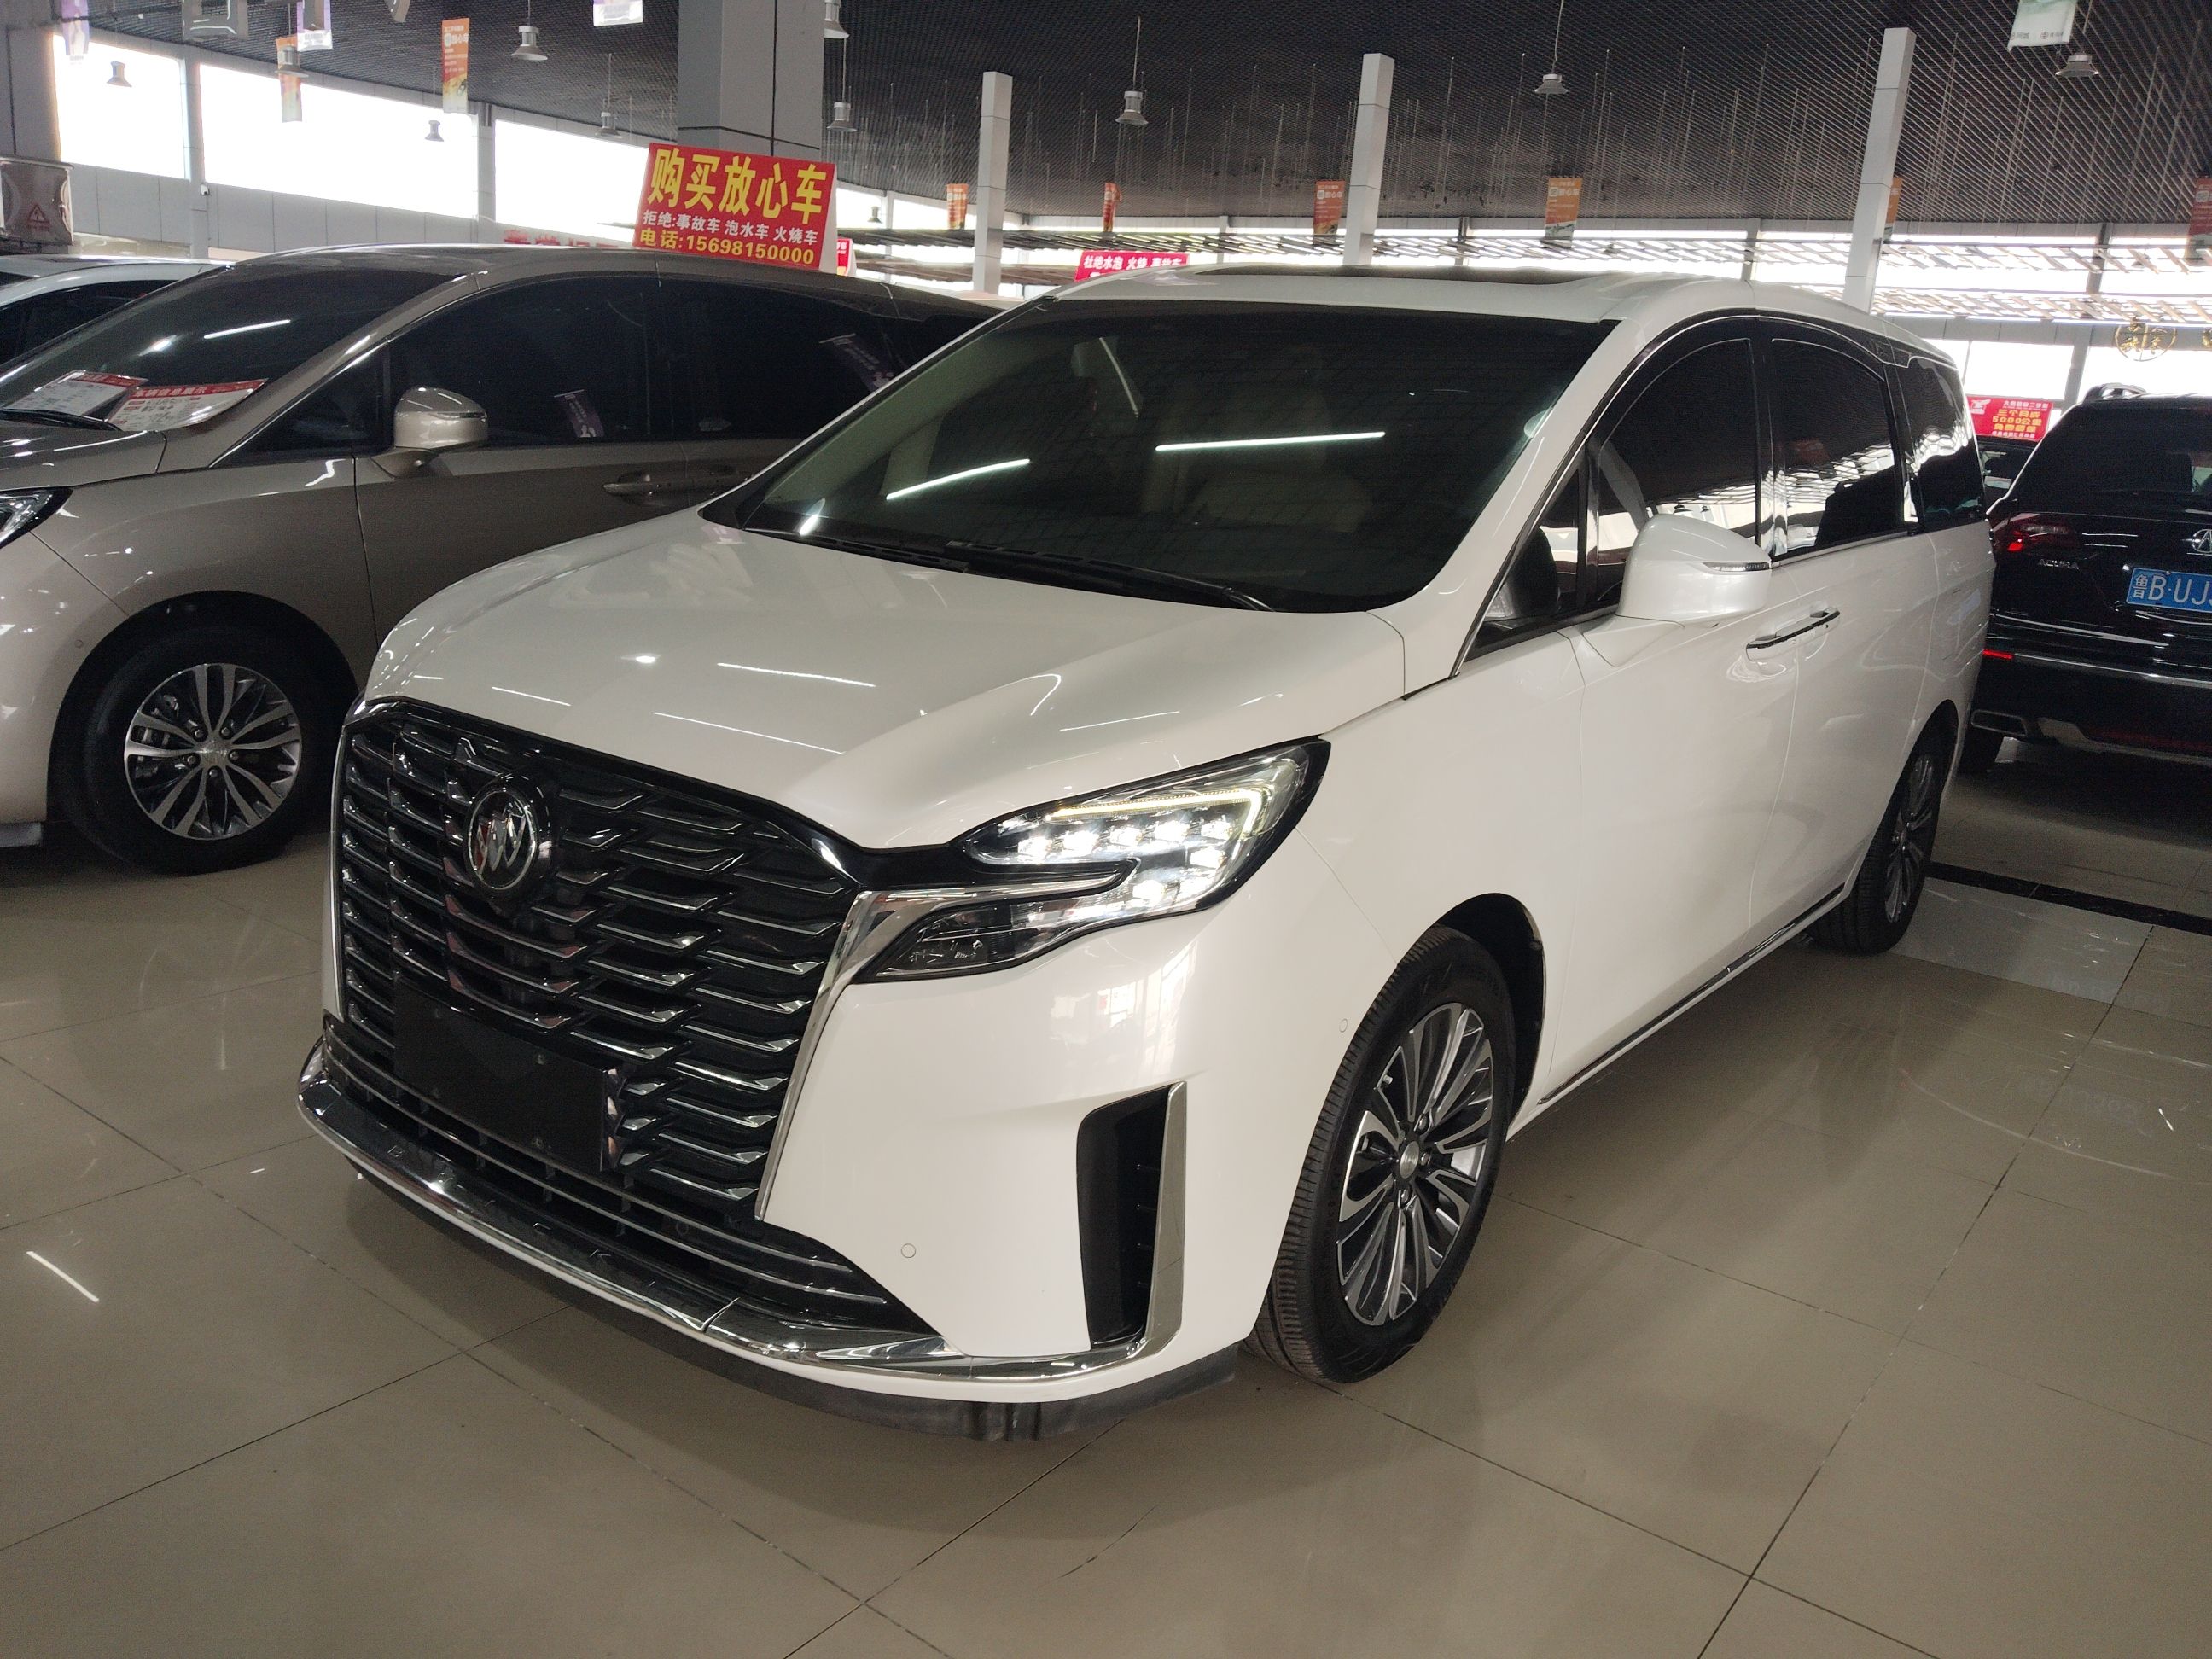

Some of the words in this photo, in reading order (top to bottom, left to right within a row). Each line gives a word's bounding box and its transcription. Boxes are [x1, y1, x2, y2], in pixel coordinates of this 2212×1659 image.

[647, 148, 827, 224] 购买放心车
[643, 210, 721, 235] 拒绝:事故车
[724, 219, 770, 240] 泡水车
[773, 228, 818, 246] 火烧车
